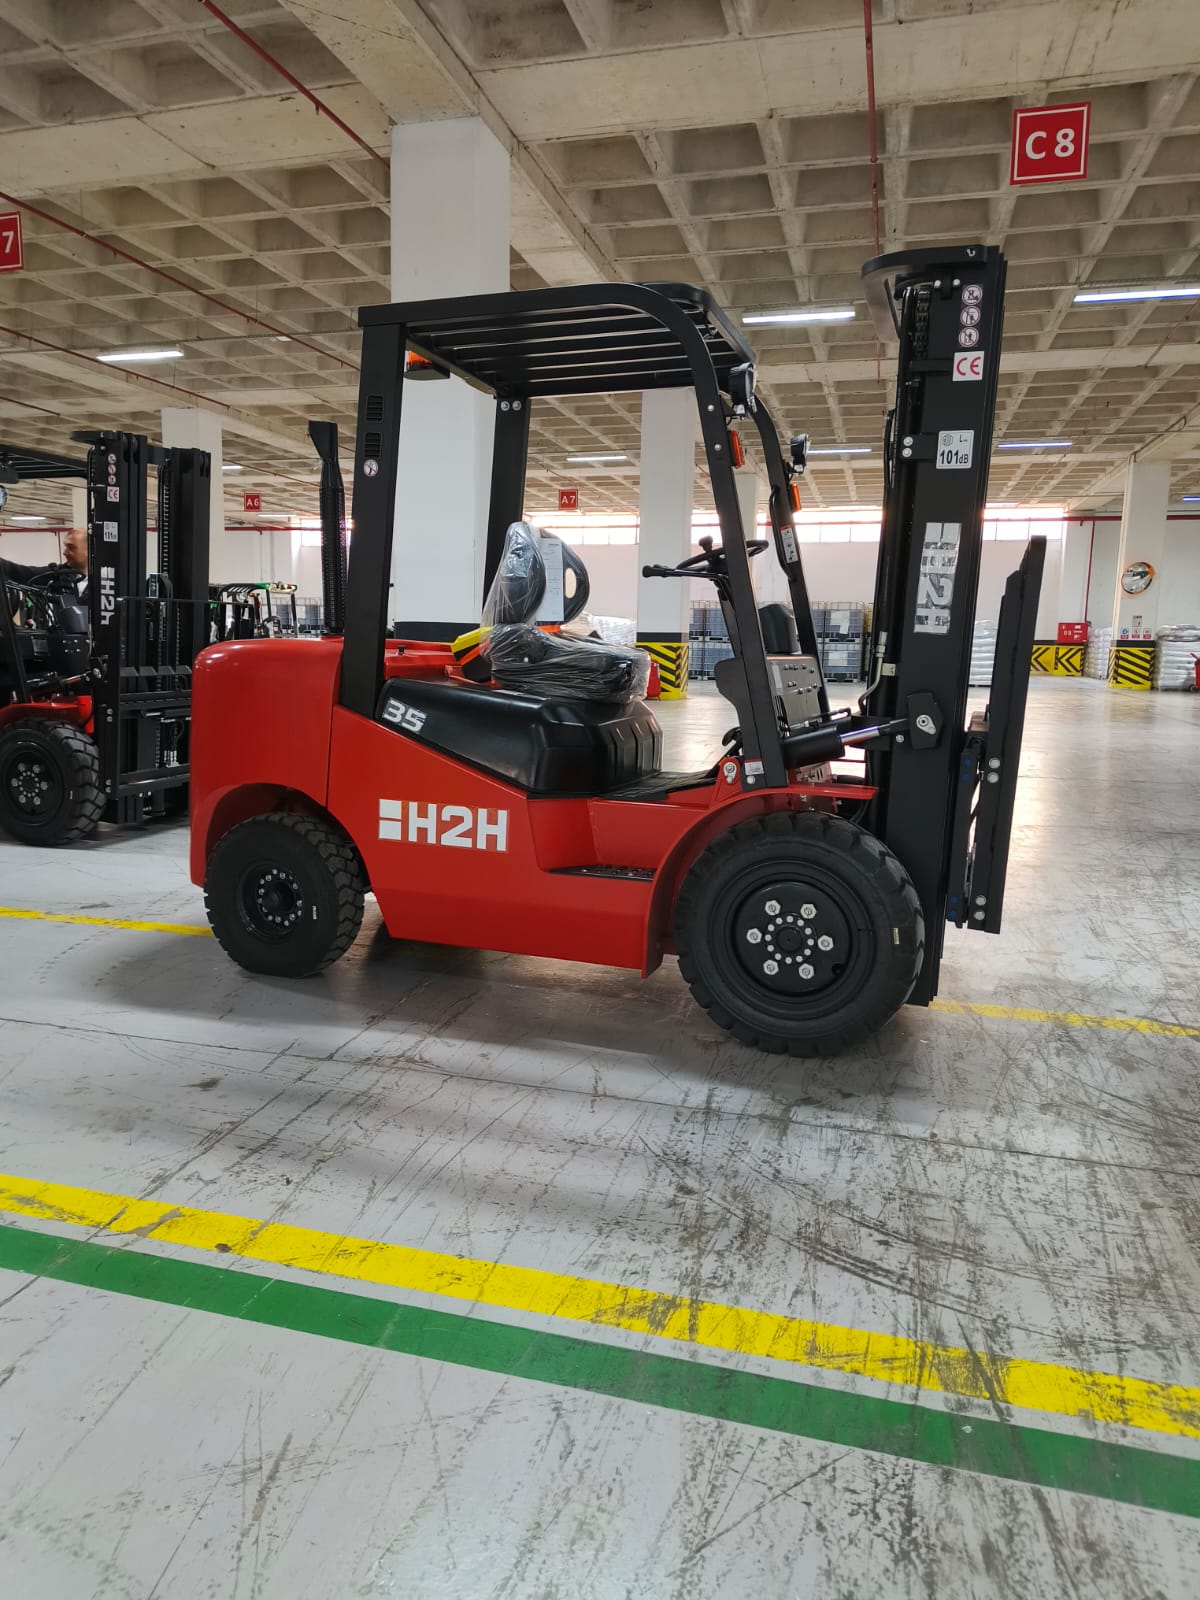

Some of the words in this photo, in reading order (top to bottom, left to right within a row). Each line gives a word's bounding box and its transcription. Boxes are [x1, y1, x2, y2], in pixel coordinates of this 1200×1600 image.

[2, 230, 14, 254] 7
[956, 356, 982, 377] CE
[382, 699, 427, 733] 35
[408, 801, 509, 852] H2H
